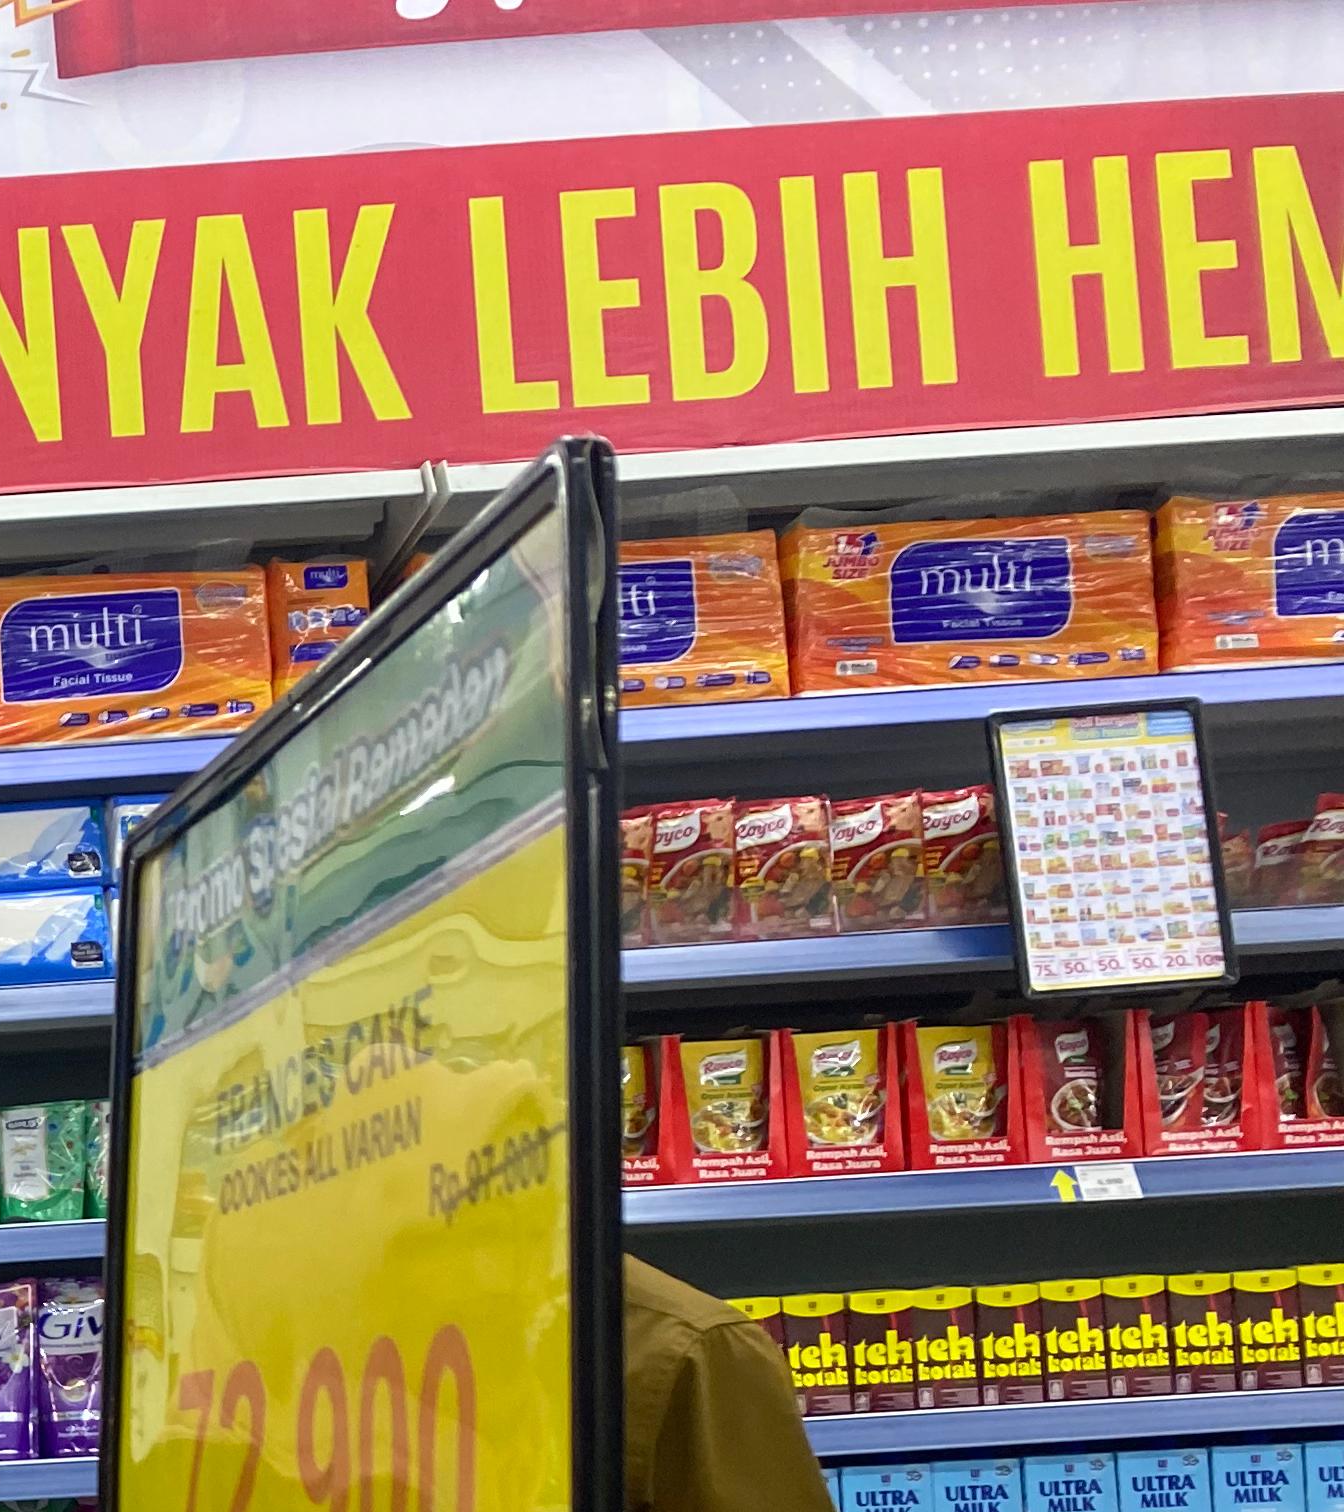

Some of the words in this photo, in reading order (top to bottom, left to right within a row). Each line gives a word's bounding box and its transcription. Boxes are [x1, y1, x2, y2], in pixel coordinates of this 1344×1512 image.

[468, 166, 958, 415] LEBIH
[919, 553, 1033, 597] multi
[29, 605, 144, 653] multi
[53, 673, 91, 687] Facial
[93, 670, 134, 684] Tissue
[342, 646, 509, 823] Ramadan
[343, 985, 434, 1097] CAKE
[303, 1133, 338, 1186] ALL
[342, 1096, 423, 1172] VARIAN
[929, 1141, 980, 1156] Rempah
[1045, 1133, 1098, 1147] Rempah
[806, 1147, 857, 1163] Rempah
[935, 1154, 964, 1166] Rasa
[967, 1151, 1004, 1163] Juara
[1051, 1146, 1082, 1157] Rasa
[1084, 1144, 1121, 1155] Juara
[693, 1155, 742, 1171] Rempah
[698, 1168, 728, 1179] Rasa
[730, 1166, 766, 1178] Juara
[812, 1161, 842, 1172] Rasa
[844, 1158, 881, 1171] Juara
[981, 1322, 1041, 1360] teh
[1045, 1317, 1105, 1355] teh
[1109, 1313, 1169, 1351] teh
[788, 1332, 848, 1370] teh
[853, 1329, 913, 1367] teh
[915, 1325, 975, 1363] teh
[918, 1361, 977, 1381] kotak
[983, 1358, 1043, 1379] kotak
[1048, 1352, 1107, 1373] kotak
[855, 1365, 914, 1386] kotak
[1039, 1478, 1103, 1497] ULTRA
[1131, 1474, 1196, 1492] ULTRA
[1225, 1469, 1290, 1487] ULTRA
[856, 1489, 920, 1507] ULTRA
[945, 1484, 1009, 1502] ULTRA
[1047, 1496, 1096, 1512] MILK
